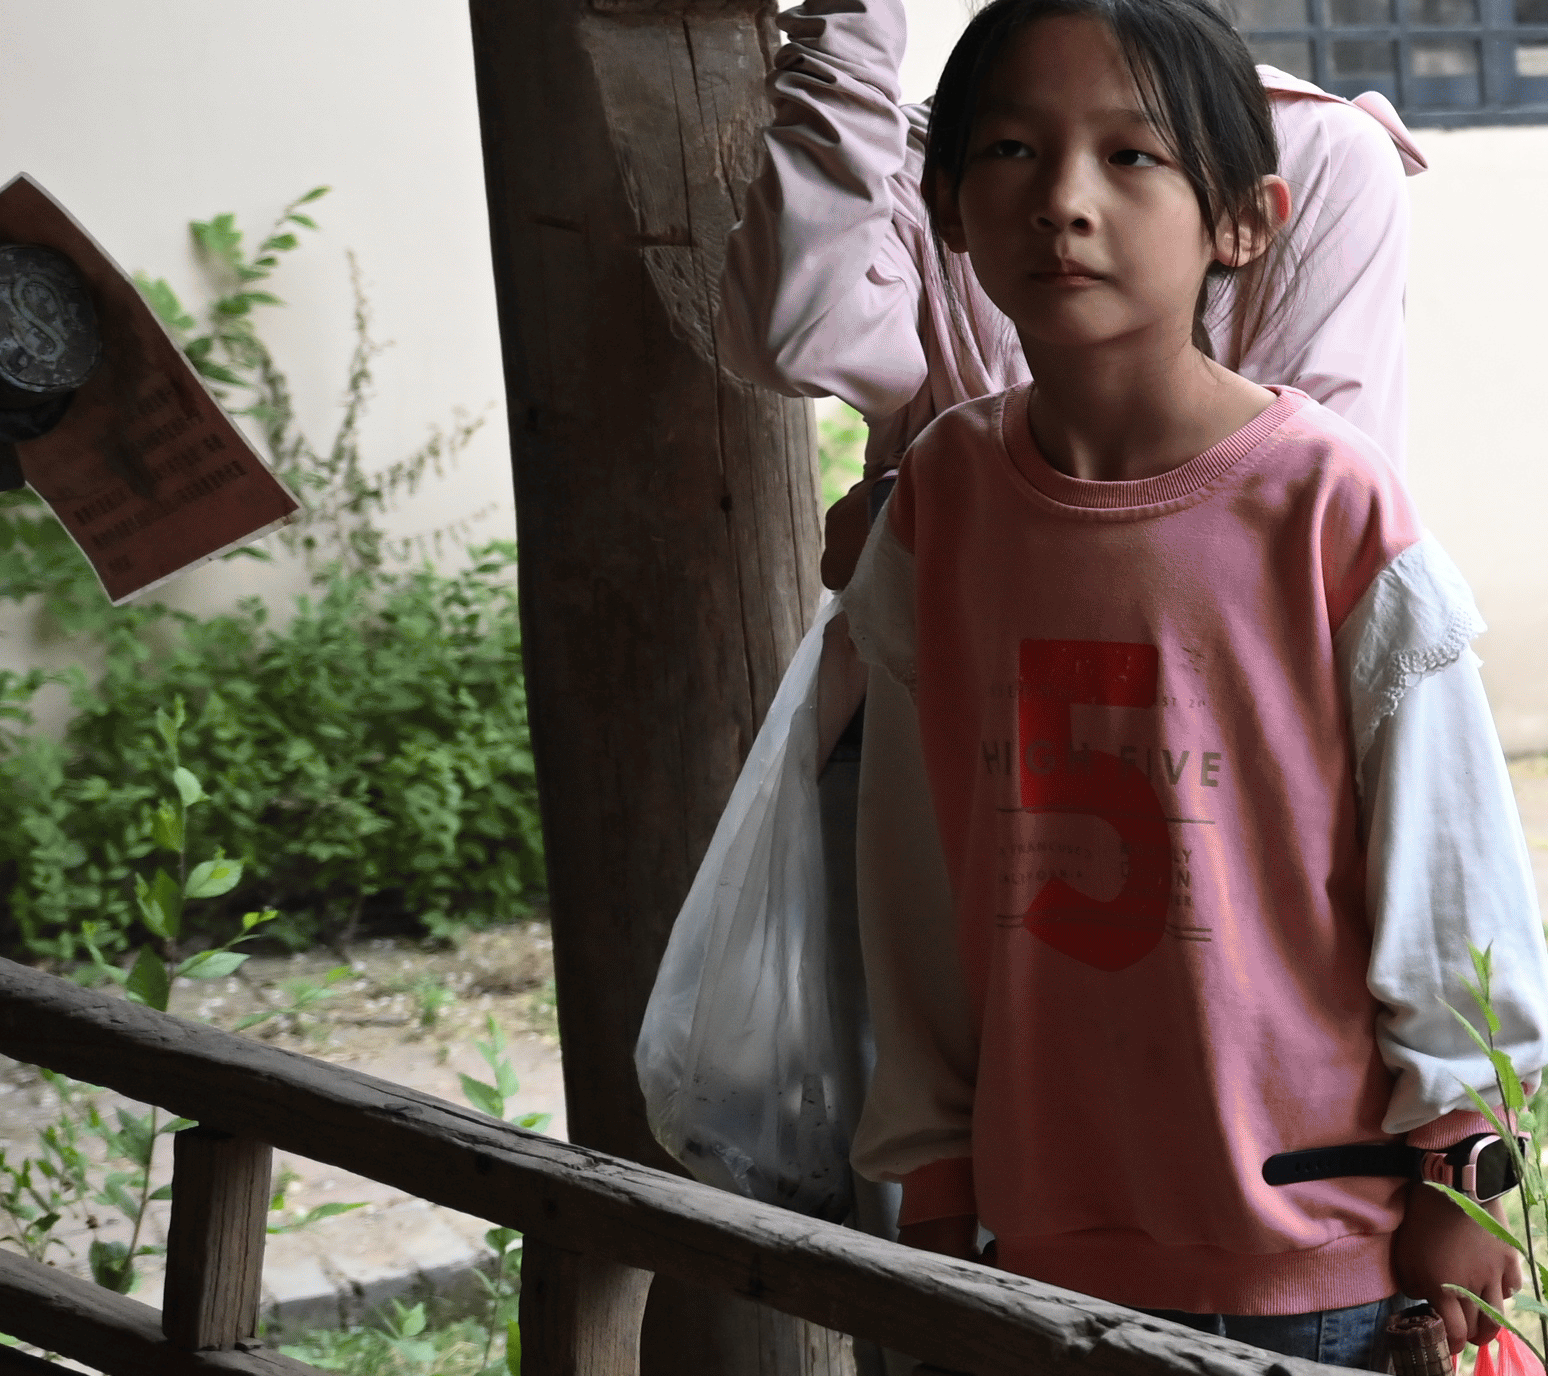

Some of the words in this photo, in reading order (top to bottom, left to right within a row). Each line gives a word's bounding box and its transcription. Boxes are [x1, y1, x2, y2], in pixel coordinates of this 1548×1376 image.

[981, 740, 1092, 776] HIGH
[1120, 745, 1223, 788] FIVE
[1018, 638, 1169, 972] 5
